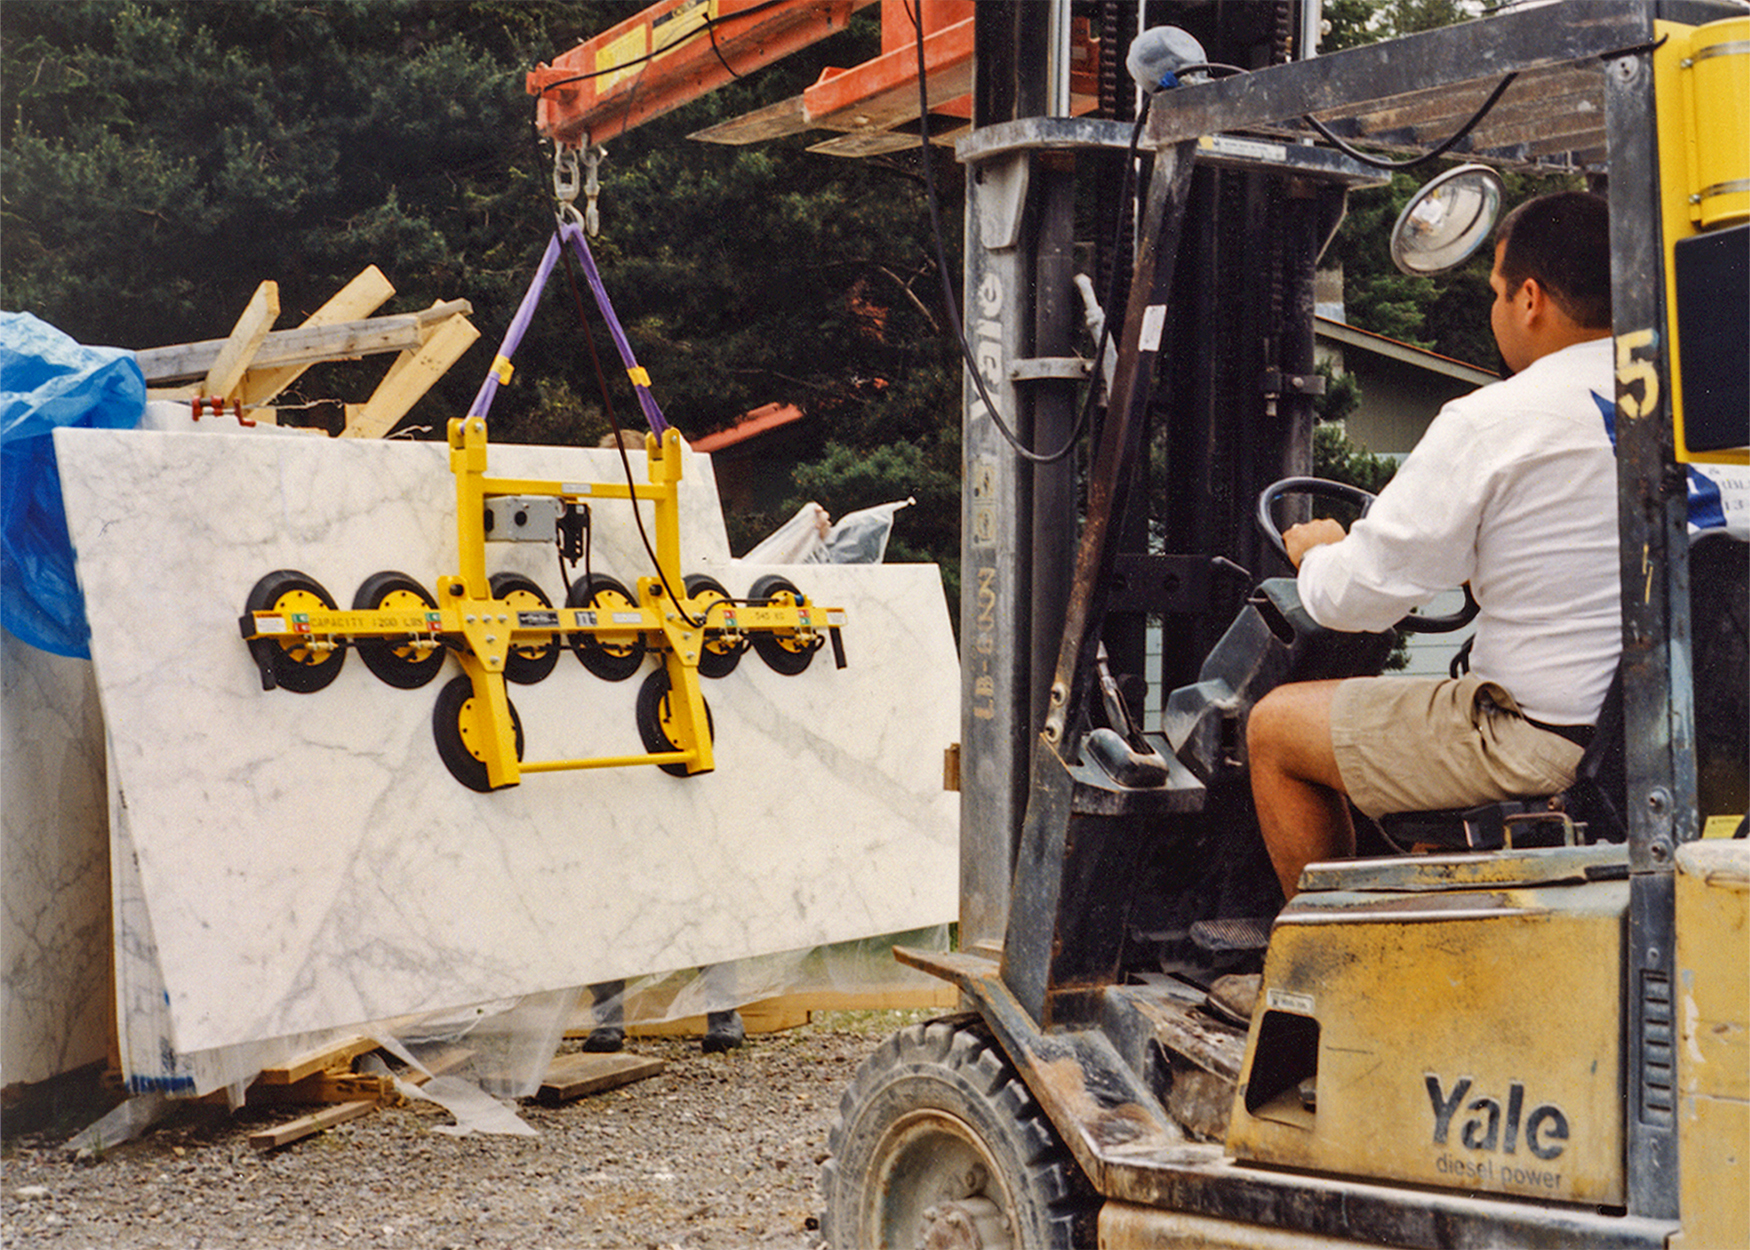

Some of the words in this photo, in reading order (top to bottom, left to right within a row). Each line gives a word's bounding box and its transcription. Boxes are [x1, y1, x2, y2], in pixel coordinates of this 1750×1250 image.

[970, 272, 1003, 422] Yale
[1615, 327, 1660, 420] 5
[310, 616, 364, 628] CAPACITY
[1424, 1073, 1570, 1161] Yale
[1436, 1153, 1494, 1181] diesel
[1501, 1165, 1562, 1190] power
